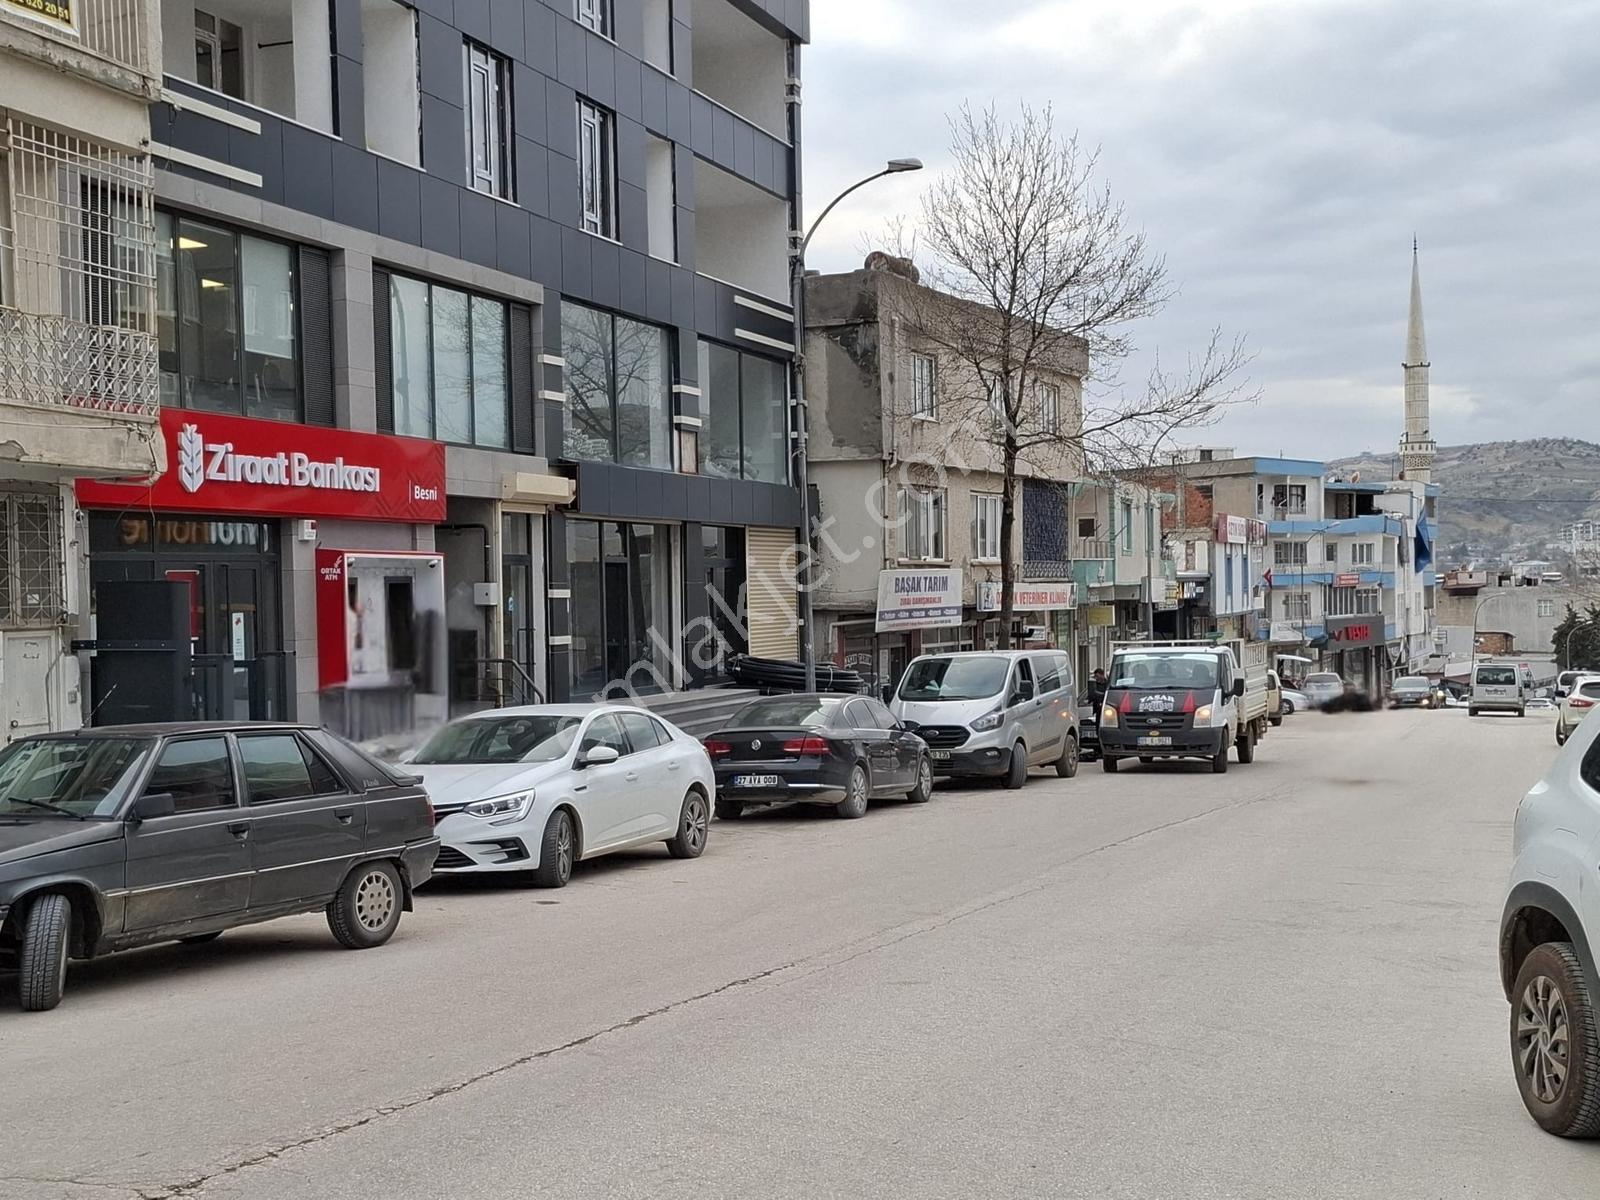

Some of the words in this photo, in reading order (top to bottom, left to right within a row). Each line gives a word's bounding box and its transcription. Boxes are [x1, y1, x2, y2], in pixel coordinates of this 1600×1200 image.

[45, 2, 57, 14] 20
[58, 6, 69, 20] 51
[203, 443, 290, 484] Ziraat
[290, 452, 380, 492] Bankası
[414, 485, 437, 501] Besni
[320, 567, 341, 575] ORTAK
[894, 576, 922, 596] BAŞAK
[923, 575, 949, 593] TARIM
